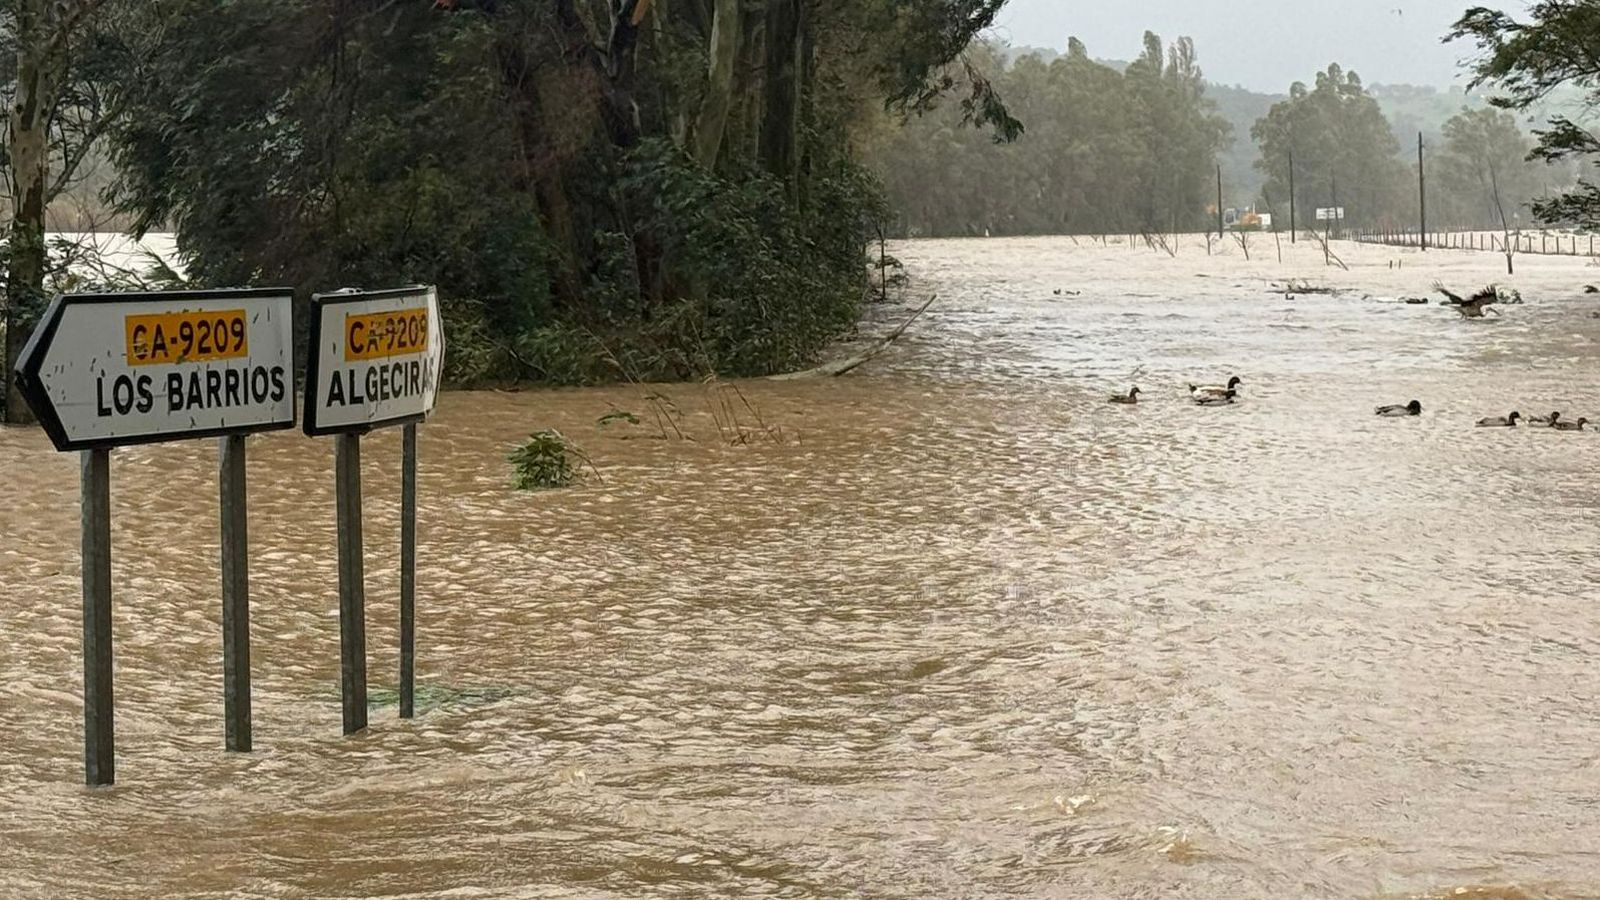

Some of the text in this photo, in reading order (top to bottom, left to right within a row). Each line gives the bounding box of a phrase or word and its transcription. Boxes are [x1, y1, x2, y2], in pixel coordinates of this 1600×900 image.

[132, 317, 245, 360] CA-9209
[349, 314, 427, 354] CA-9209
[97, 366, 285, 417] LOS BARRIOS
